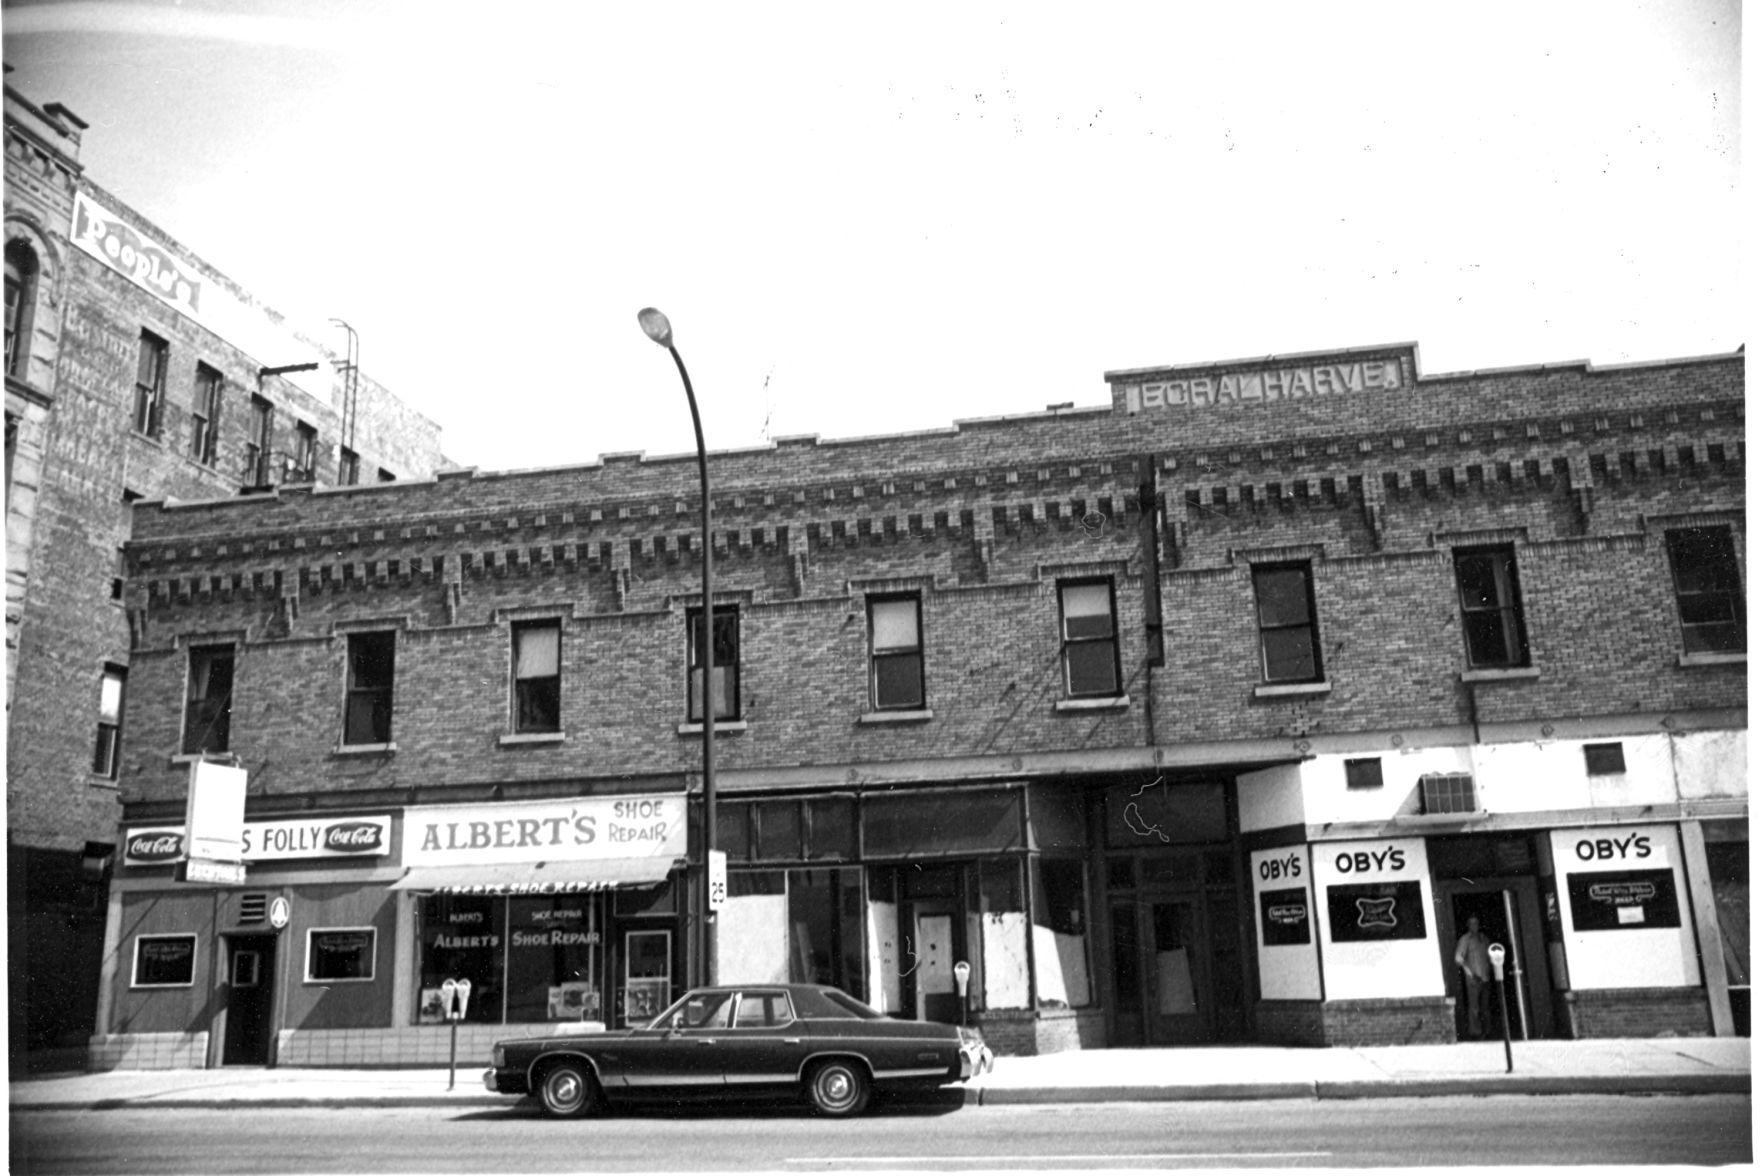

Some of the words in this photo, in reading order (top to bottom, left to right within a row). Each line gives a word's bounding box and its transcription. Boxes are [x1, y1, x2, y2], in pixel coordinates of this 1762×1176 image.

[82, 209, 193, 303] People's
[613, 799, 664, 819] SHOE
[262, 827, 321, 851] FOLLY
[420, 809, 597, 851] ALBERT'S
[609, 822, 667, 842] REPAIR
[1335, 845, 1406, 873] OBY'S
[1575, 832, 1652, 861] OBY'S
[1260, 852, 1302, 880] OBY'S
[433, 933, 499, 949] ALBERT'S
[512, 930, 549, 946] SHOE
[551, 929, 600, 945] REPAIR
